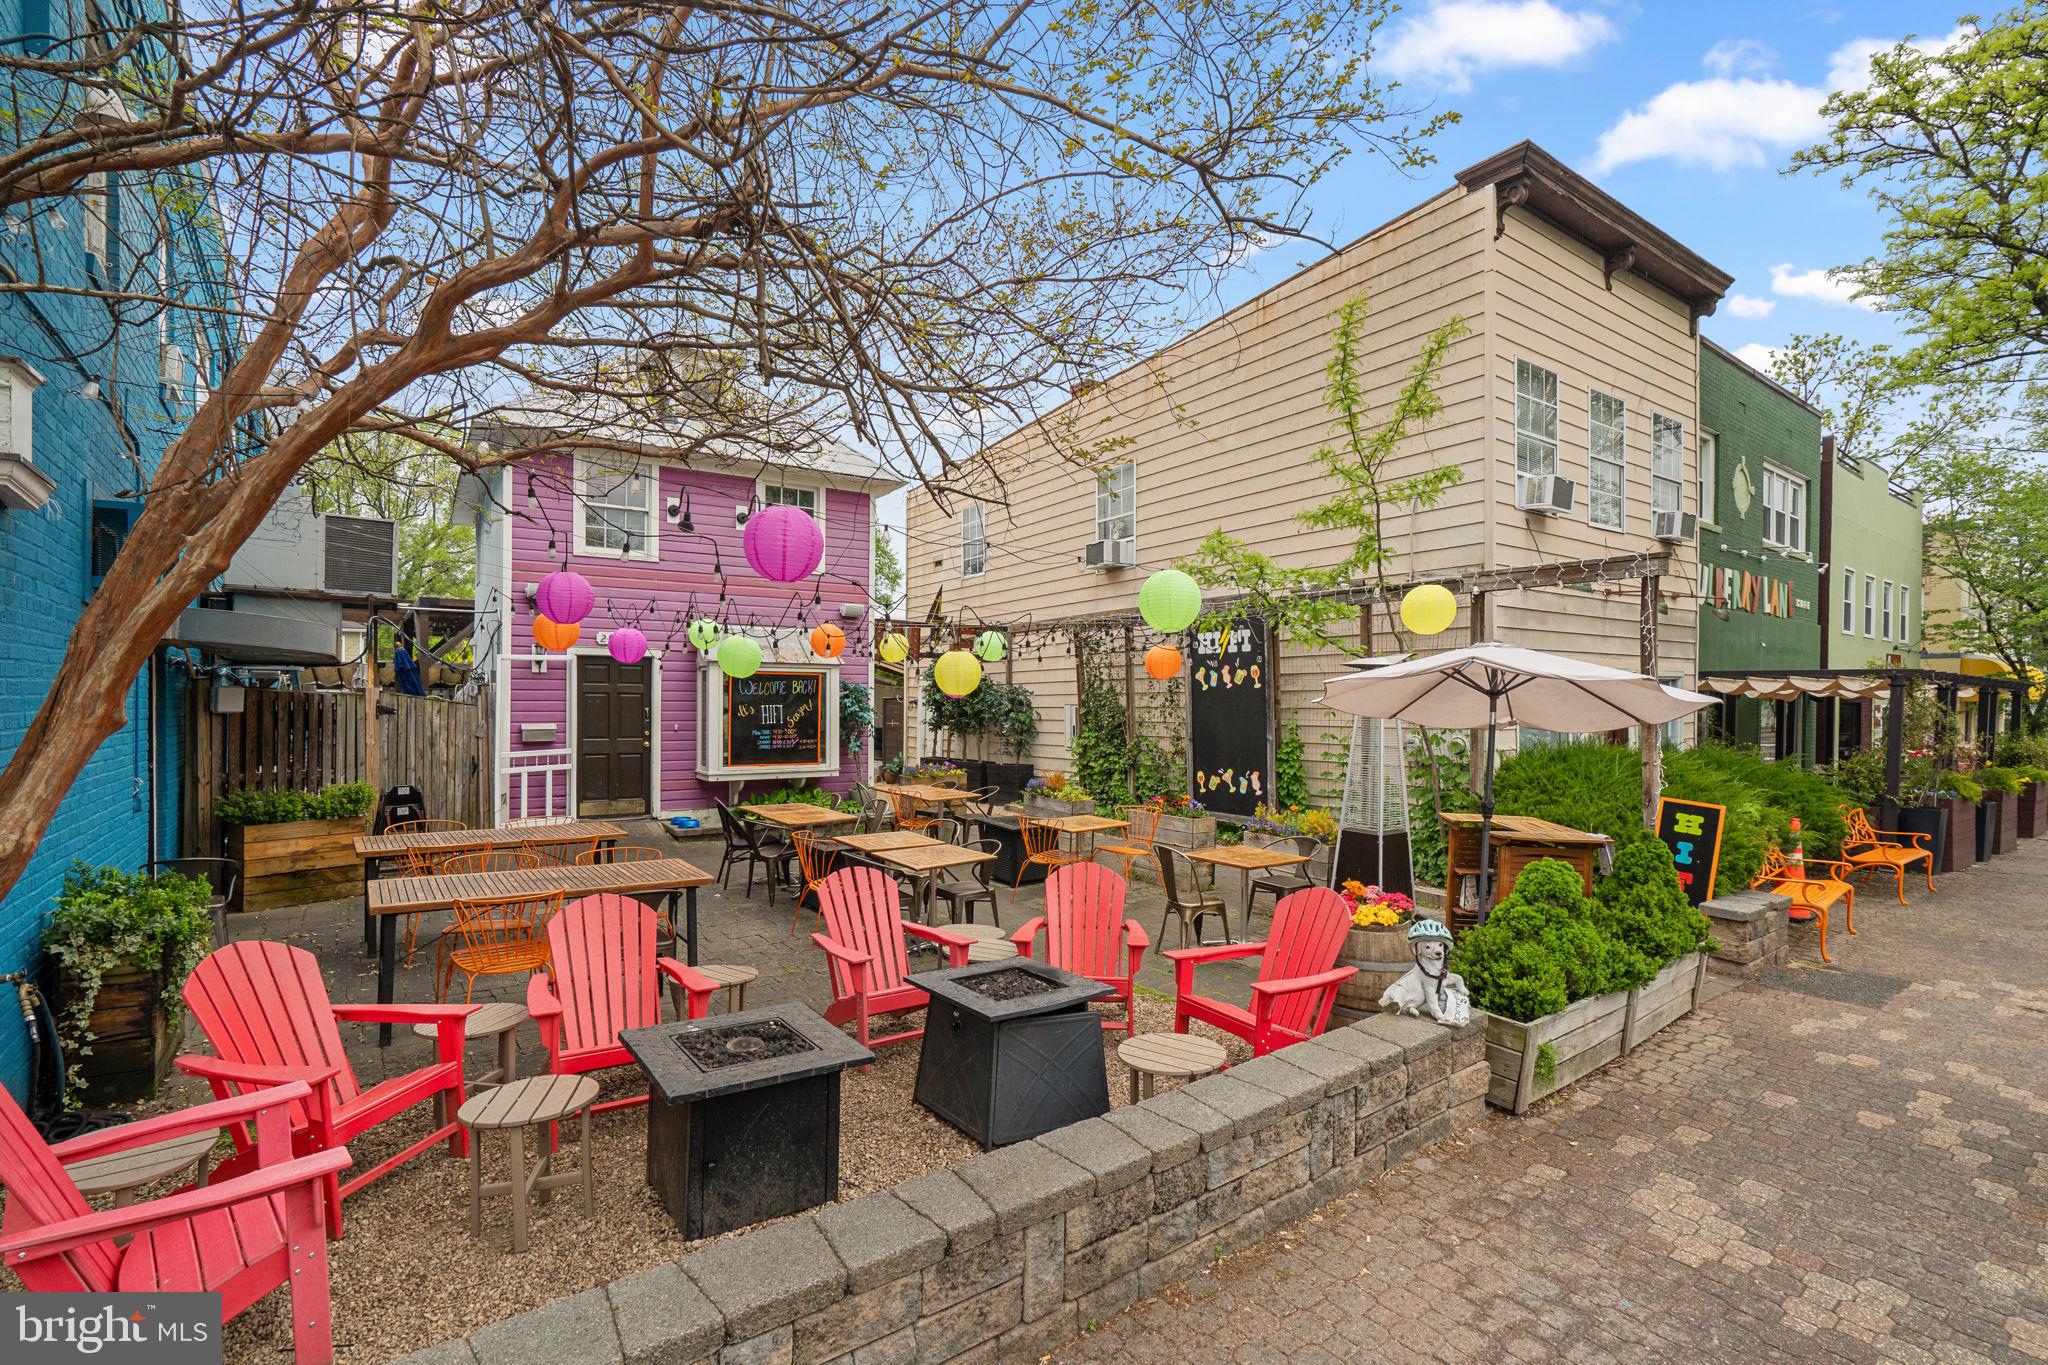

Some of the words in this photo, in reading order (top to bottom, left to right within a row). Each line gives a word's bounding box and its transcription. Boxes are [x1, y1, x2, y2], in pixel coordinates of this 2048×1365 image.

[1763, 576, 1795, 618] LANE
[739, 680, 787, 695] WELCOME
[792, 680, 817, 695] BACK!
[761, 704, 784, 724] HIFI
